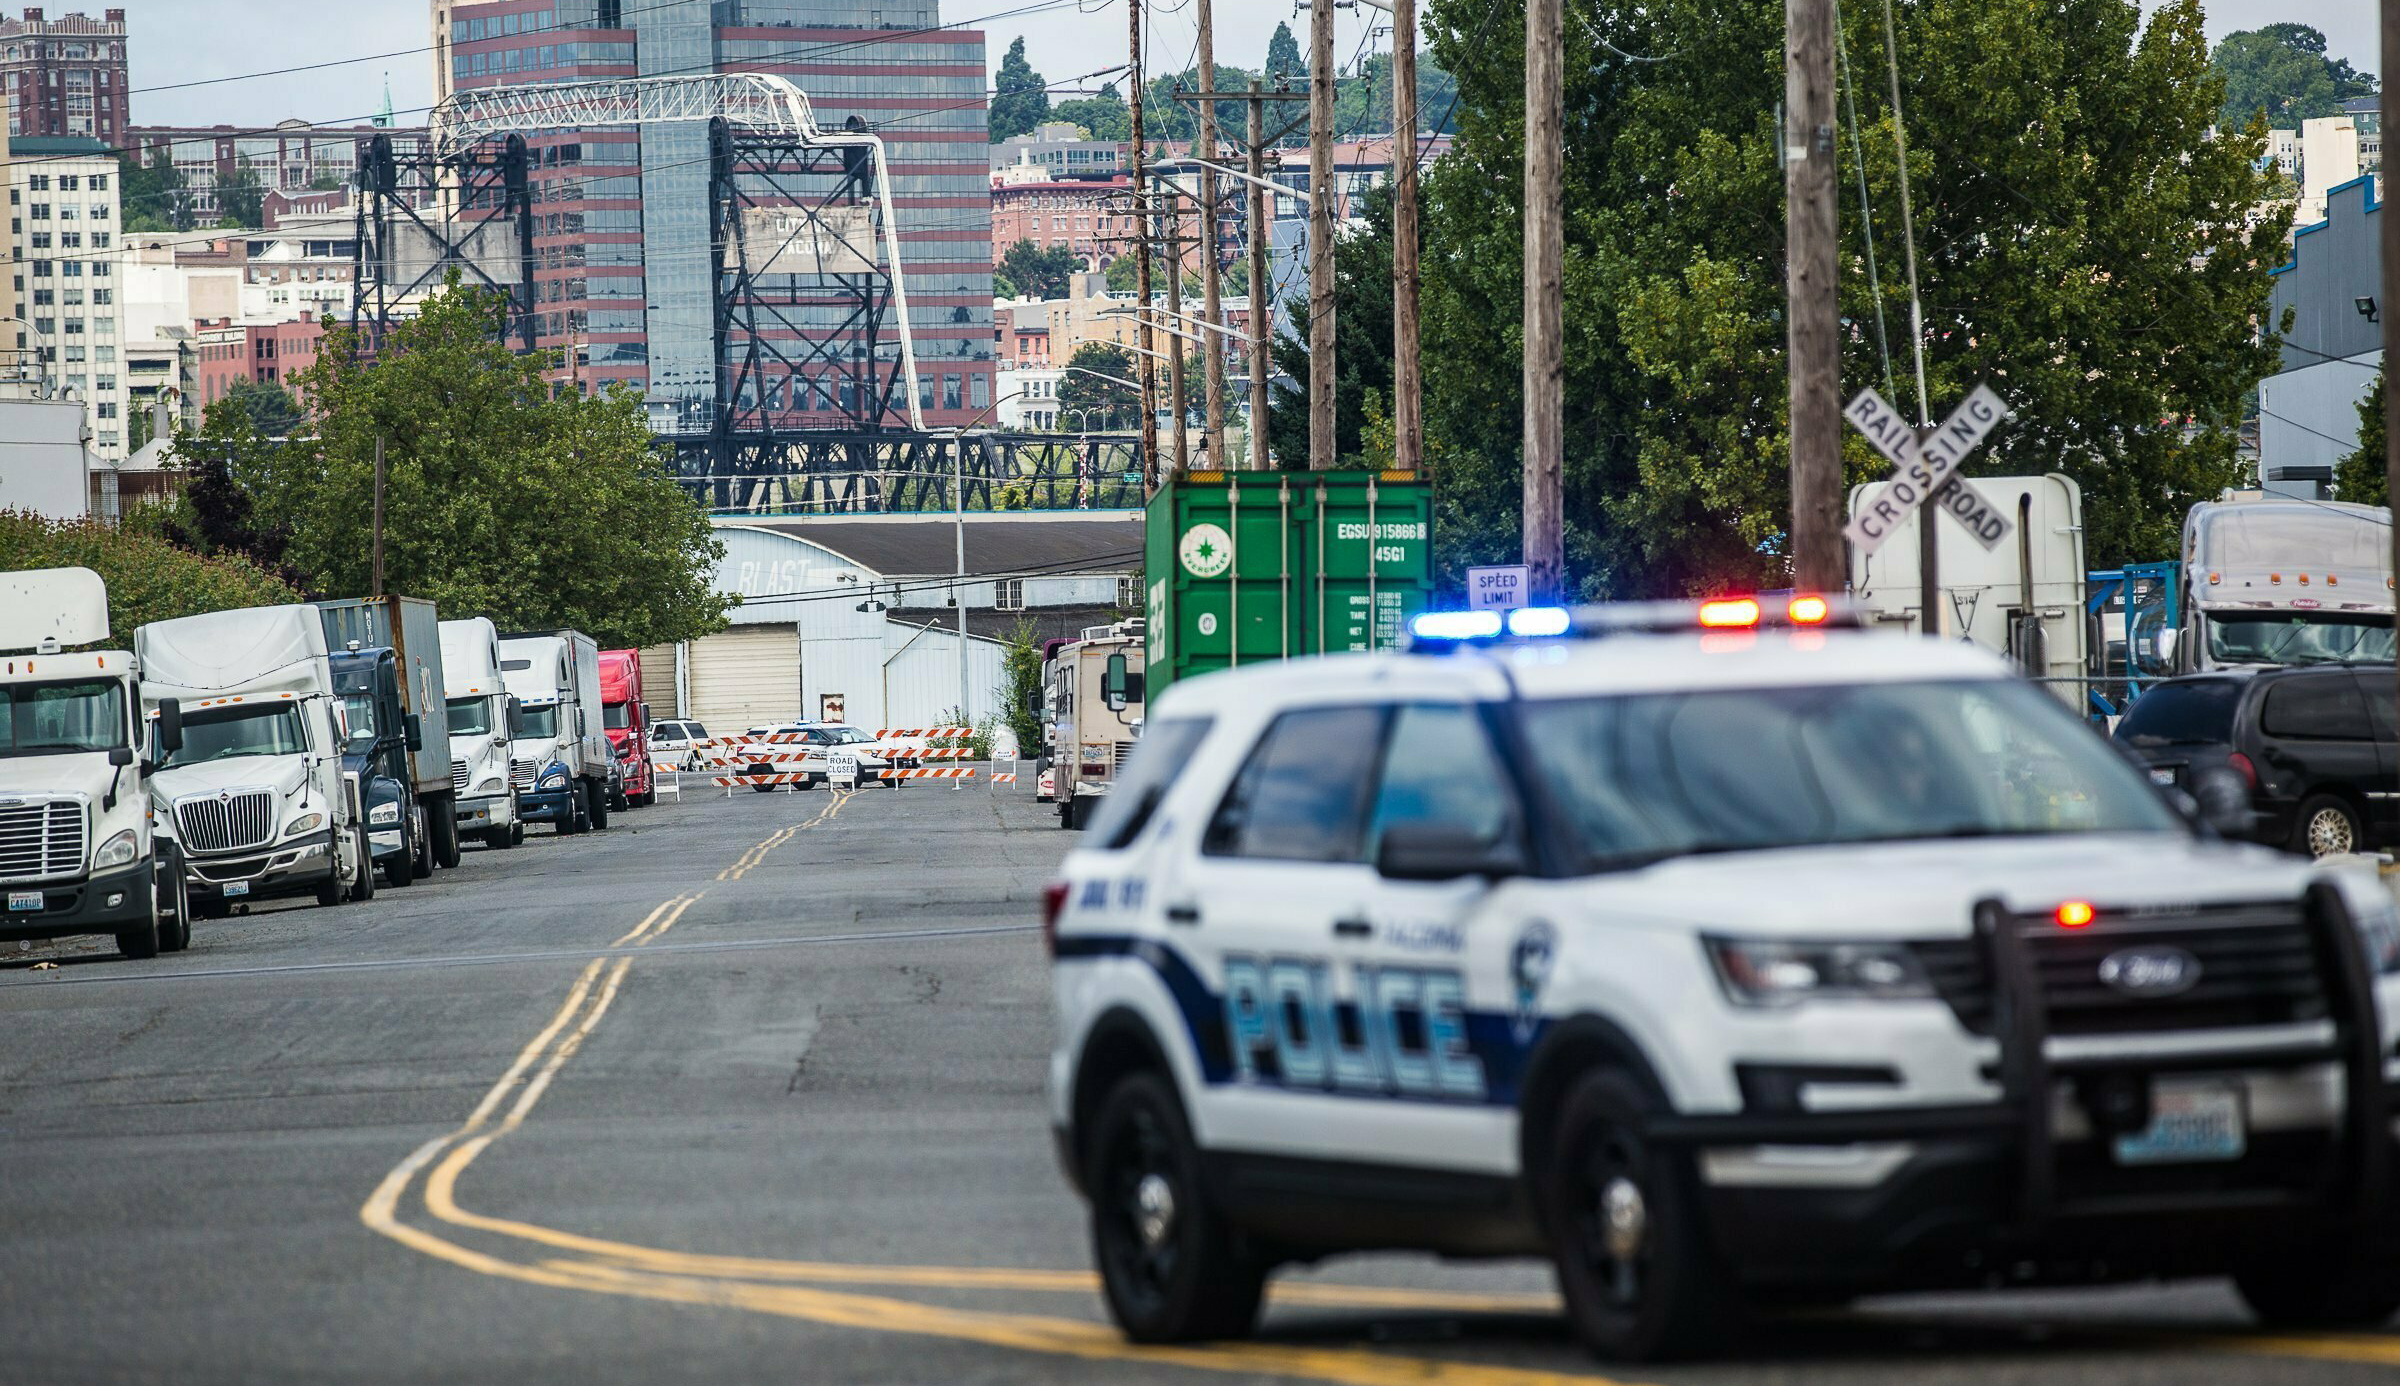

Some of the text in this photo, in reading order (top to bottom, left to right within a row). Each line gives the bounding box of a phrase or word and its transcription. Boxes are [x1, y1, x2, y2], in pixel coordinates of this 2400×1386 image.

[1854, 398, 1911, 461] RAIL
[1861, 400, 1994, 539] CROSSING
[1941, 477, 2004, 542] ROAD
[1338, 523, 1370, 540] EGSU
[1184, 552, 1228, 573] EVERGREEN
[1375, 546, 1405, 562] 45G1
[738, 559, 811, 597] BLAST
[1480, 575, 1517, 588] SPEED
[1484, 591, 1513, 604] LIMIT
[828, 766, 856, 774] CLOSED
[829, 757, 853, 765] ROAD
[1224, 955, 1488, 1098] POLICE
